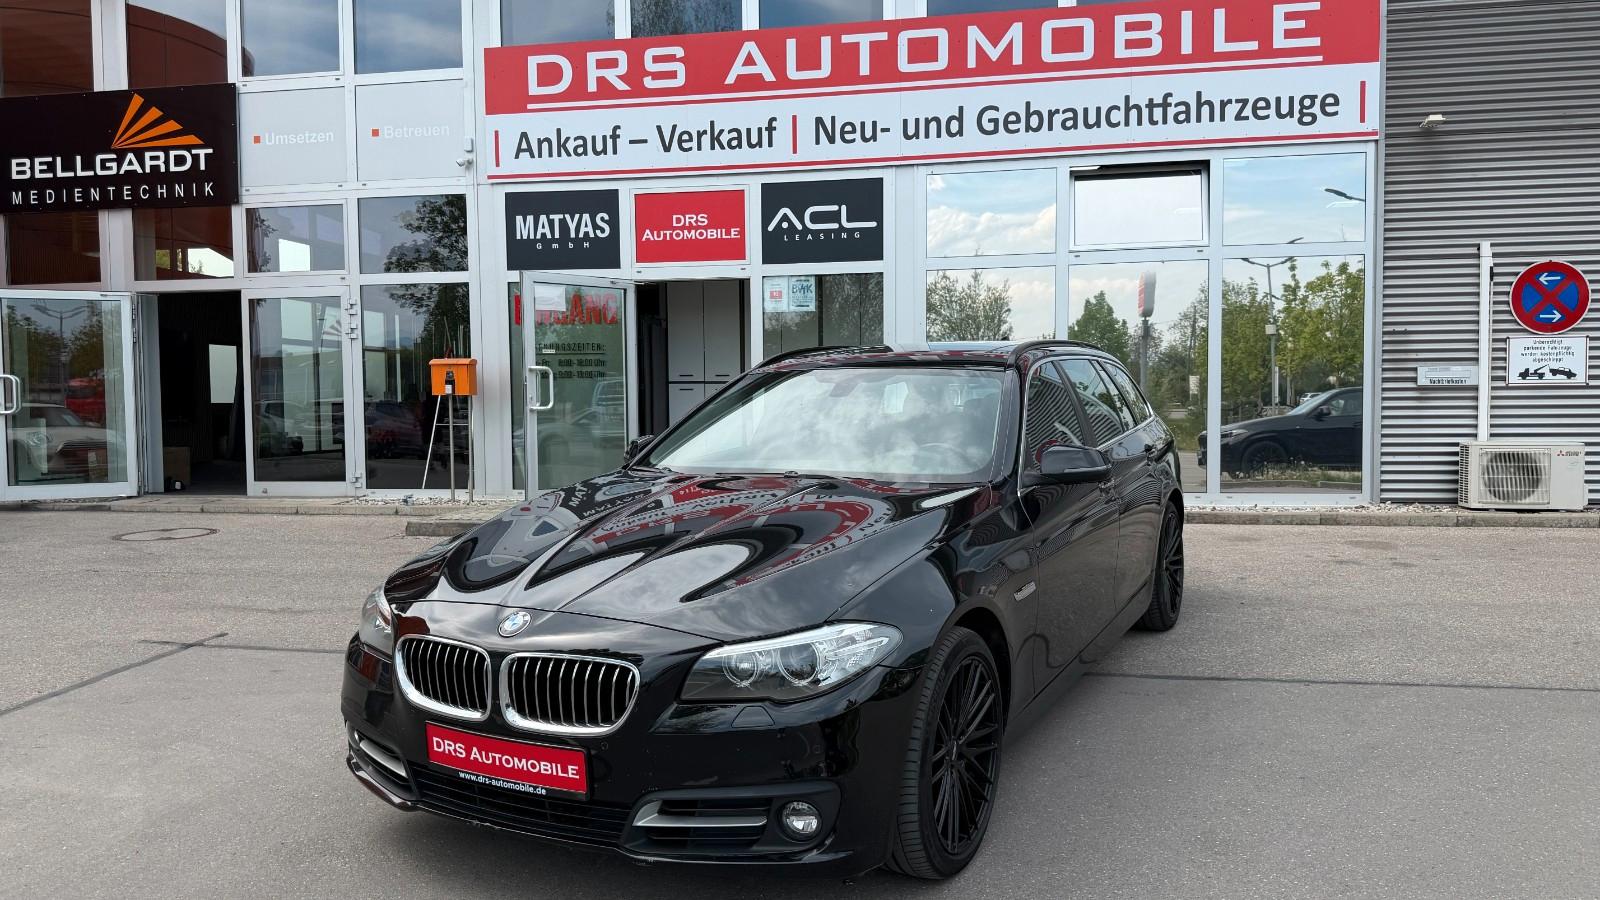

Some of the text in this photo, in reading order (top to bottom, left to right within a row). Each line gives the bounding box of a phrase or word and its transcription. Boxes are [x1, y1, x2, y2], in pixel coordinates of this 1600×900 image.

[527, 2, 1321, 96] DRS AUTOMOBILE
[383, 123, 450, 140] Betreuen
[813, 91, 1340, 146] Neu- und Gebrauchtfahrzeuge
[265, 130, 335, 147] Umsetzen
[513, 124, 621, 160] Ankauf
[655, 116, 777, 153] Verkauf
[10, 148, 214, 180] BELLGARDT
[12, 182, 215, 206] MEDIENTECHNIK
[515, 212, 610, 240] MATYAS
[672, 213, 709, 227] DRS
[767, 204, 878, 232] ACL
[641, 228, 741, 242] AUTOMOBILE
[783, 230, 861, 241] LEASING
[432, 736, 580, 779] DRS AUTOMOBILE
[459, 771, 546, 795] www.drs-automobile.de
